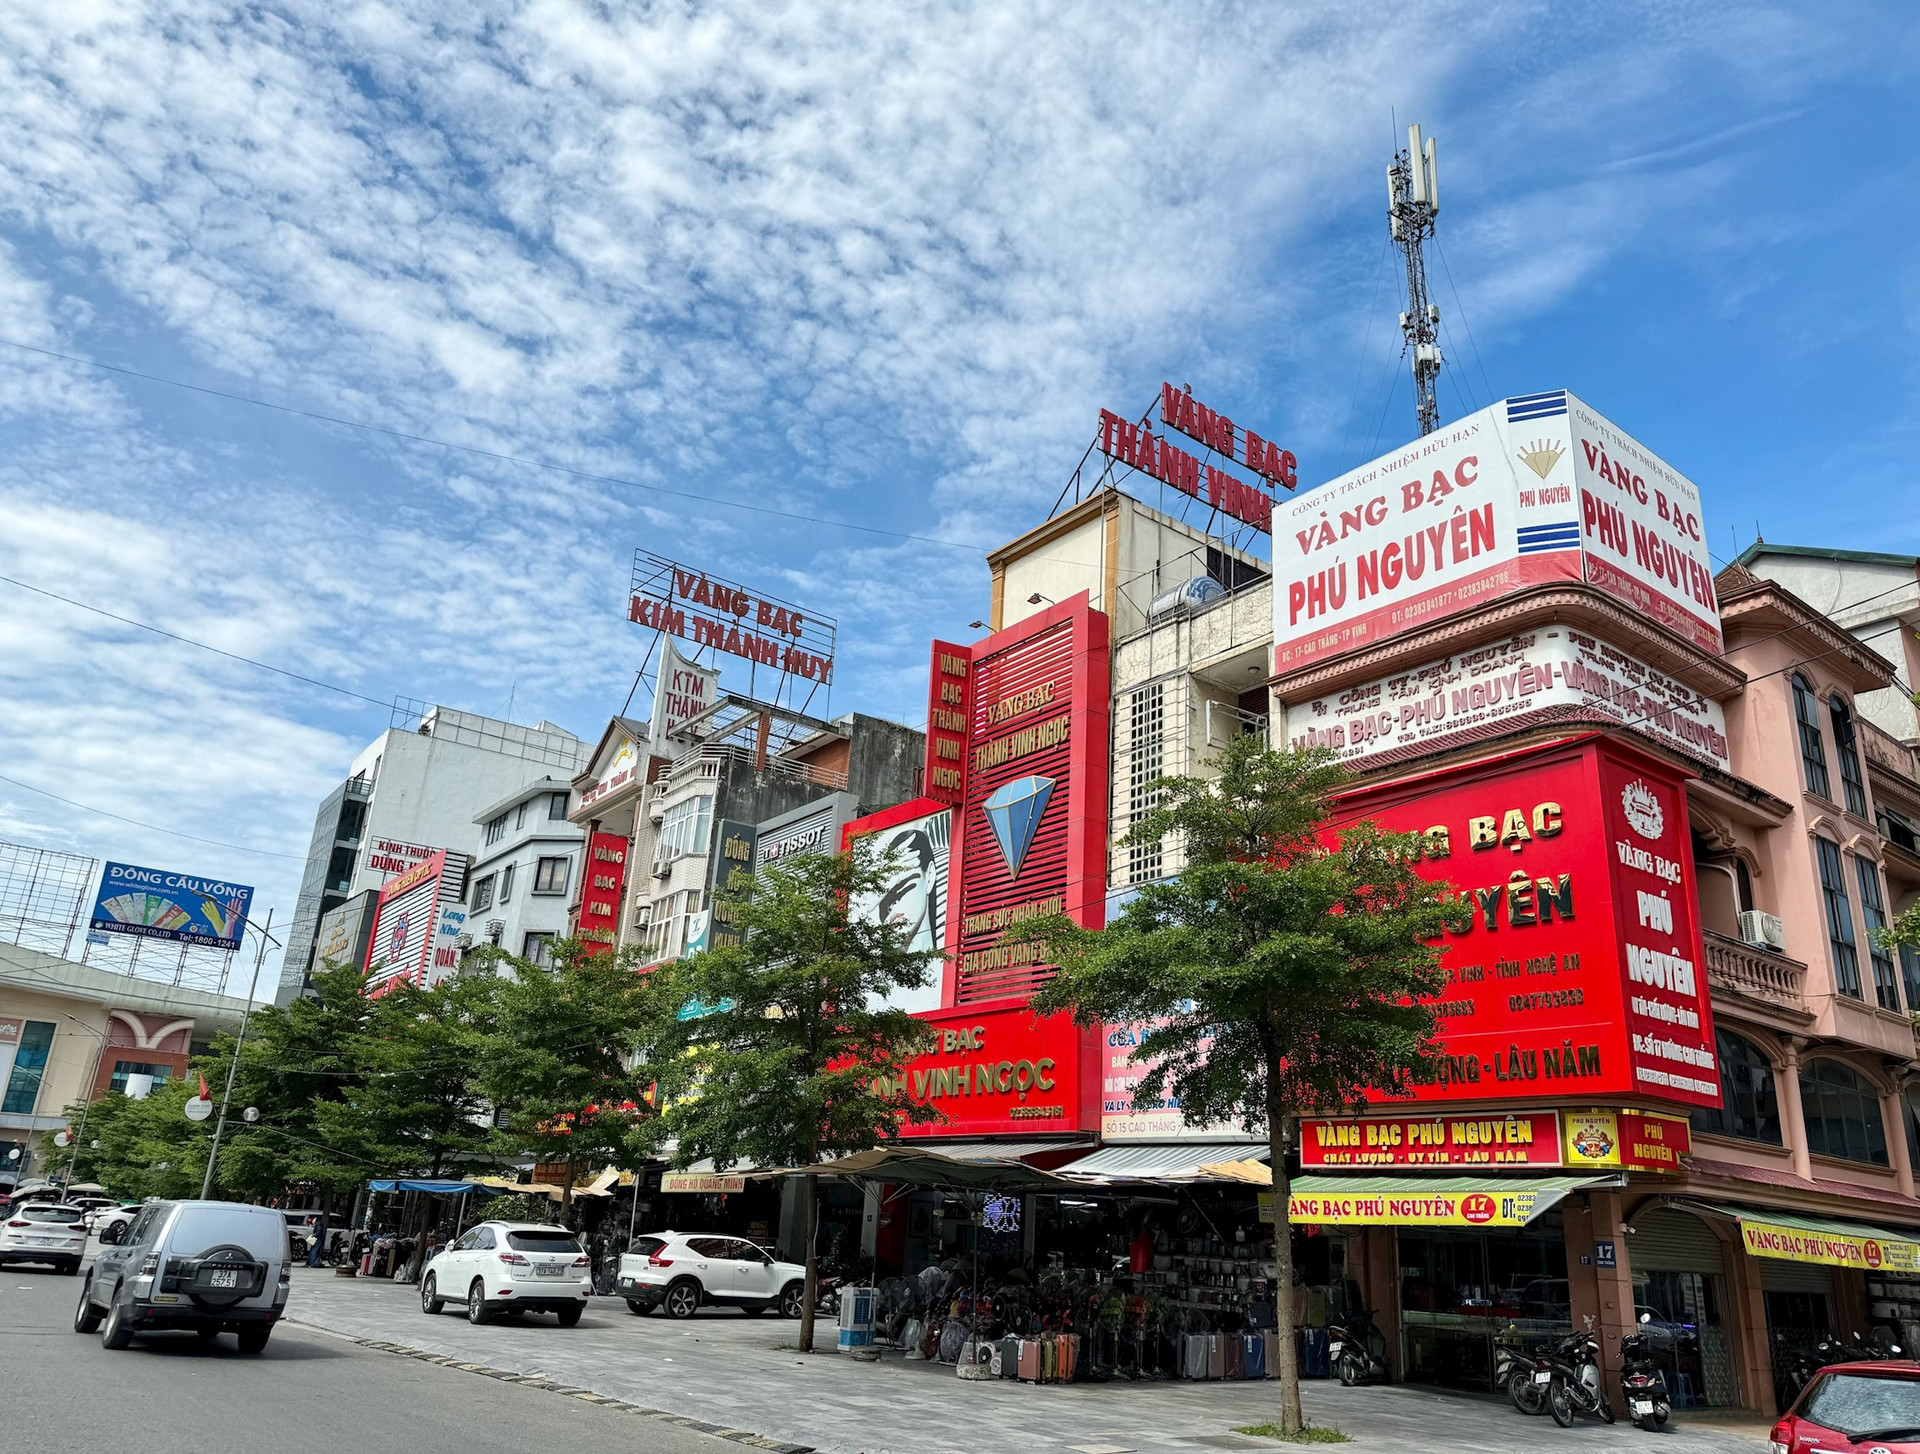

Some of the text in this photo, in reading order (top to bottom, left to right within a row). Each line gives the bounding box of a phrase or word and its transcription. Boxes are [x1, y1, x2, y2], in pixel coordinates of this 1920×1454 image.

[1162, 381, 1298, 489] VÀNG BẠC
[1576, 408, 1600, 431] CÔNG
[1599, 424, 1611, 439] TY
[1100, 407, 1272, 534] THÀNH VINH
[1292, 423, 1480, 517] CÔNG TY TRÁCH NHIỆM HỮU HẠN
[1519, 483, 1571, 509] PHÚ NGUYÊN
[1581, 437, 1700, 543] VÀNG BẠC
[1295, 456, 1478, 556] VÀNG BẠC
[1289, 502, 1496, 626] PHÚ NGUYÊN
[1581, 487, 1717, 614] PHÚ NGUYÊN
[676, 571, 803, 637] VÀNG BẠC
[630, 595, 832, 684] KIM THÀNH HUY
[940, 652, 966, 678] VÀNG
[1339, 635, 1536, 707] CÔNG NGUYÊN
[672, 669, 705, 698] KIM
[941, 682, 962, 706] BẠC
[1333, 698, 1381, 719] TRUNG
[1388, 685, 1420, 702] TÂM
[1428, 670, 1462, 691] KINH
[1469, 651, 1525, 679] DOANH
[932, 707, 966, 734] THÀNH
[936, 737, 960, 761] VINH
[975, 715, 1069, 772] THÀNH VINH NGỌC
[1673, 711, 1728, 760] NGUYÊN
[932, 766, 961, 792] NGỌC
[779, 825, 825, 856] TISSOT
[1468, 800, 1564, 853] BẠC
[378, 839, 403, 854] KÍNH
[594, 845, 624, 864] VÀNG
[371, 854, 405, 873] DŨNG
[1616, 838, 1681, 886] VÀNG BẠC
[110, 866, 162, 885] ĐÔNG
[165, 874, 199, 891] CẦU
[594, 874, 616, 891] BẠC
[442, 908, 465, 924] Long
[589, 901, 611, 916] KIM
[1636, 889, 1674, 936] PHÚ
[104, 922, 147, 937] WHITE GLOVE
[965, 915, 992, 934] TRANG
[963, 952, 979, 973] GIA
[1563, 953, 1581, 972] AN
[1625, 947, 1697, 998] NGUYÊN
[943, 1026, 986, 1057] BẠC
[1494, 1038, 1602, 1082] LÂU NĂM
[913, 1057, 1055, 1100] VINH NGỌC
[1105, 1101, 1115, 1112] VA
[1116, 1100, 1126, 1111] LY
[1106, 1119, 1118, 1133] SỐ
[1119, 1122, 1127, 1133] 15
[1128, 1121, 1148, 1133] CAO
[1316, 1114, 1534, 1151] VÀNG BẠC PHÚ NGUYÊN
[1643, 1122, 1663, 1140] PHÚ
[1355, 1151, 1394, 1165] LƯỢNG
[1408, 1152, 1425, 1163] UY
[1427, 1150, 1449, 1163] TÍN
[1464, 1150, 1490, 1163] LÂU
[1633, 1142, 1673, 1162] NGUYÊN
[700, 1177, 722, 1191] QUANG
[723, 1177, 743, 1190] MINH
[1288, 1195, 1319, 1215] ÀNG
[1323, 1200, 1351, 1220] BẠC
[1355, 1195, 1385, 1216] PHÚ
[1389, 1195, 1456, 1217] NGUYÊN
[1468, 1198, 1488, 1212] 17
[1596, 1245, 1613, 1258] 17
[1746, 1227, 1780, 1250] VÀNG
[1782, 1235, 1802, 1257] BẠC
[1804, 1236, 1824, 1257] PHÚ
[1825, 1240, 1861, 1261] NGUYÊN
[1866, 1244, 1876, 1256] 17
